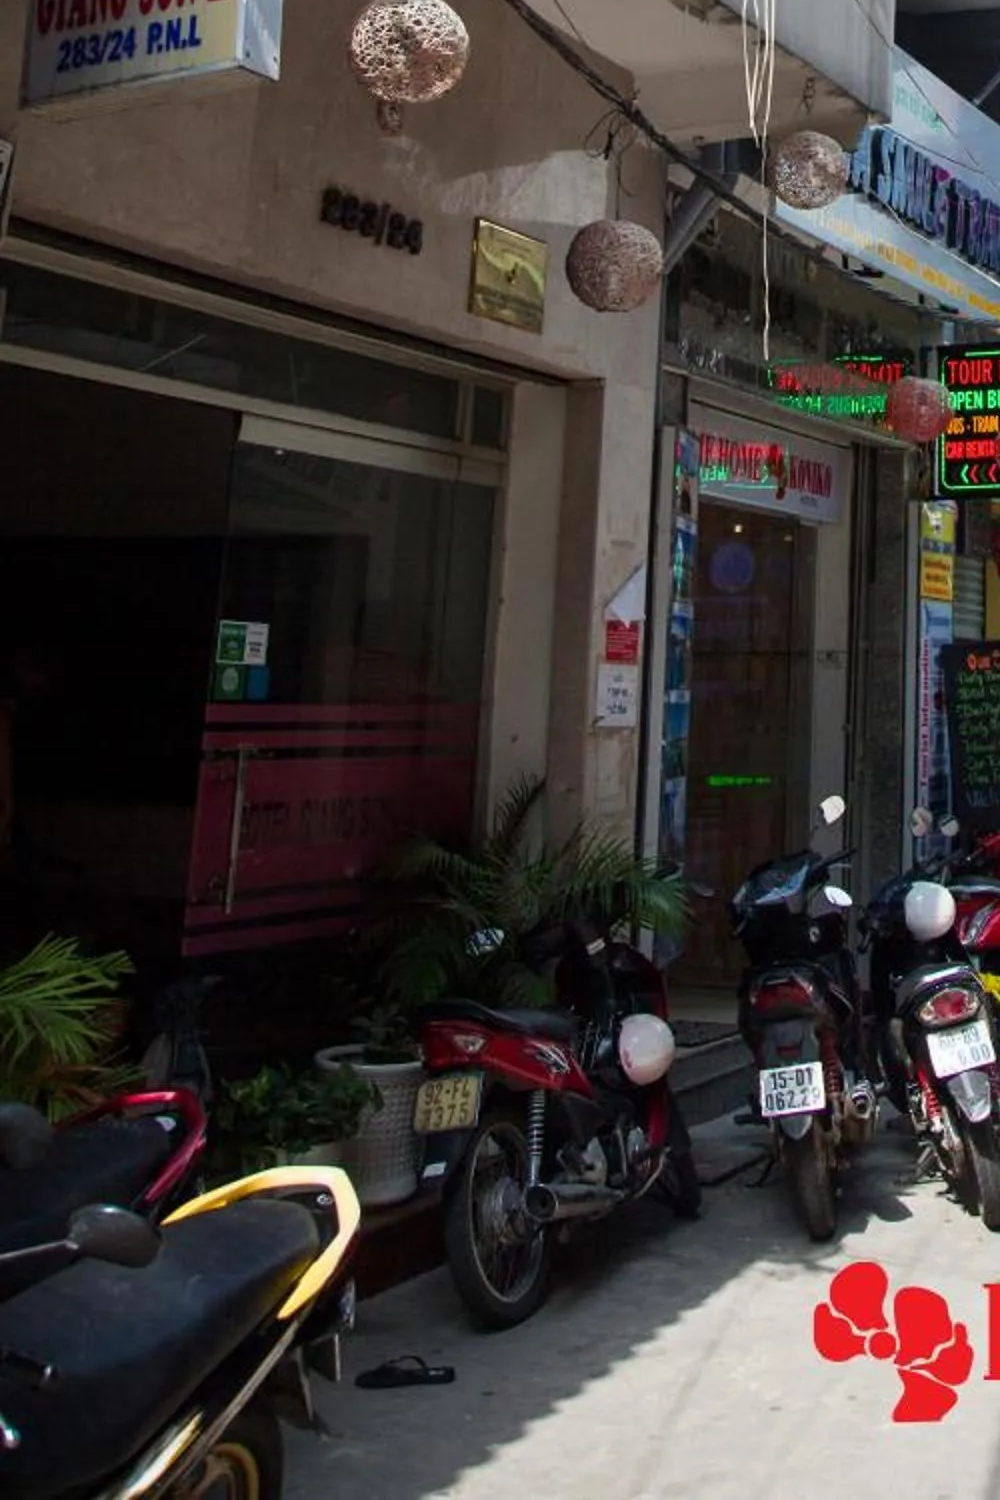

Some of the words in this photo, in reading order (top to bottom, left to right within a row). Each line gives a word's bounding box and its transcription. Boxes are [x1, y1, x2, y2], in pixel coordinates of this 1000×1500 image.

[56, 26, 136, 73] 283/24
[947, 358, 993, 385] TOUR
[948, 389, 983, 411] OPEN
[972, 414, 999, 433] TRAIN
[965, 439, 999, 459] RENTA
